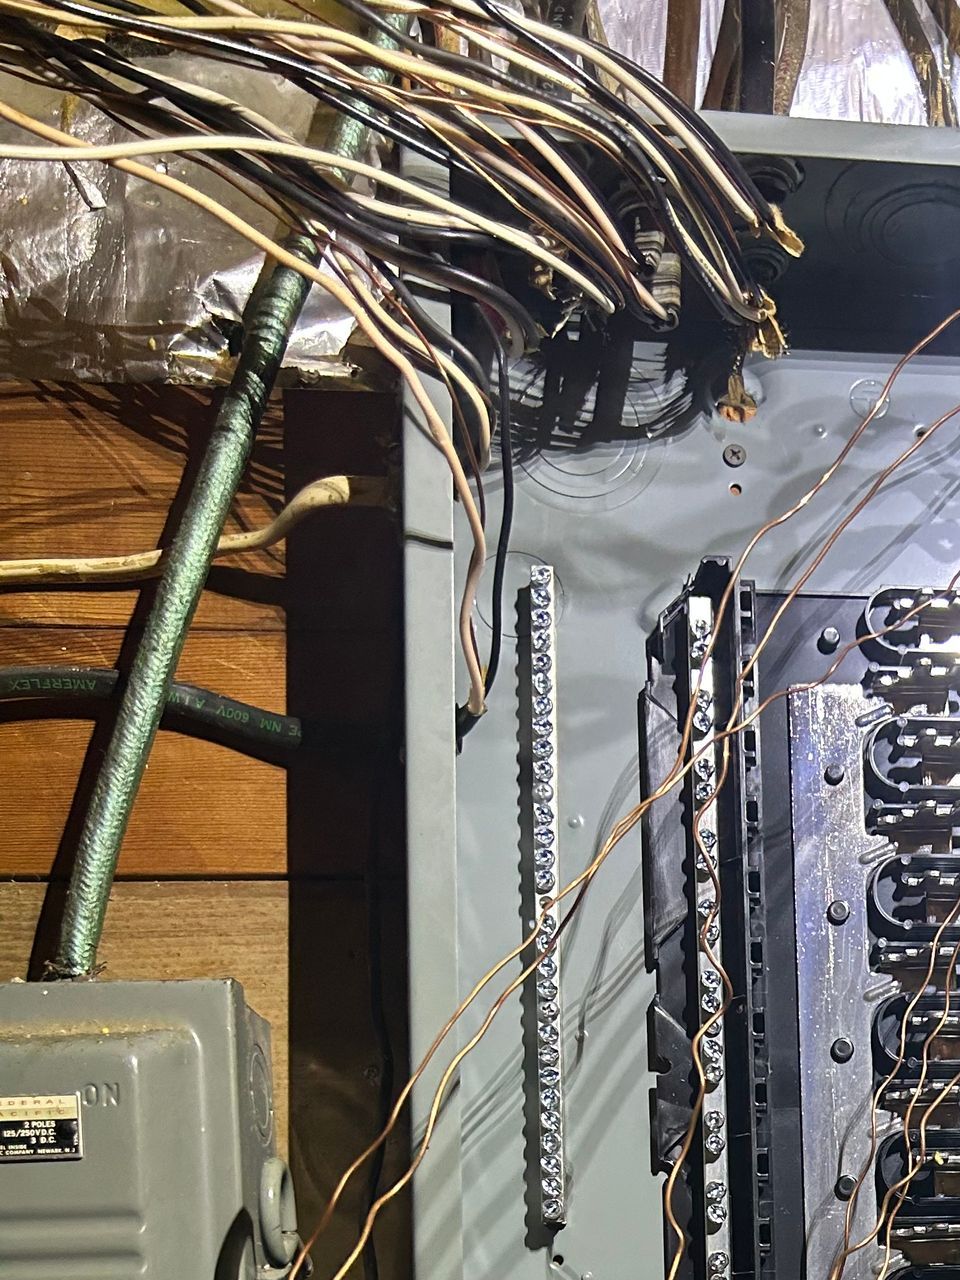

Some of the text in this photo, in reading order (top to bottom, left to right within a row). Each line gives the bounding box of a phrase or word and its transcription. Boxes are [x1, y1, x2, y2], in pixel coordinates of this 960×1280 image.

[9, 678, 97, 691] AMERFLEX
[216, 704, 250, 724] 600V
[259, 717, 283, 733] NM
[81, 1082, 121, 1107] ON
[24, 1120, 56, 1129] 2 POLES
